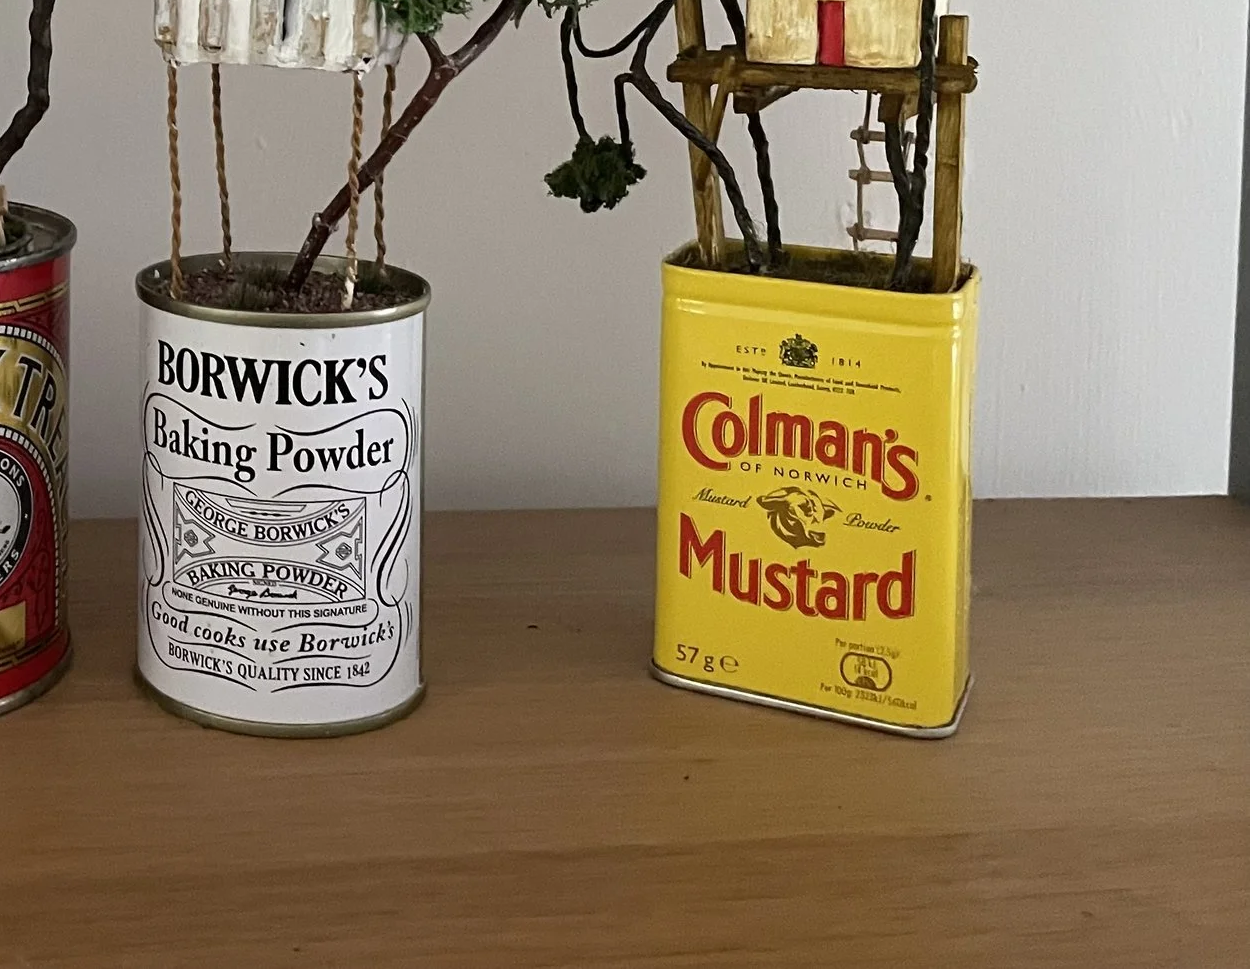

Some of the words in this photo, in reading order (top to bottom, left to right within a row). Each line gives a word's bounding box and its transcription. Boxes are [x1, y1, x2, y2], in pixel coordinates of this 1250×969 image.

[158, 339, 389, 406] BORWICK'S
[831, 357, 861, 369] 1814
[153, 407, 257, 483] Baking
[266, 428, 394, 473] Powder
[682, 391, 920, 502] Colman's
[740, 461, 762, 473] OF
[773, 466, 868, 490] NORWICH
[185, 490, 248, 538] GEORGE
[254, 503, 351, 542] BORWICK'S
[692, 486, 753, 509] Mustard
[843, 512, 902, 534] Powder
[186, 562, 256, 586] BAKING
[262, 563, 348, 600] POWDER
[679, 511, 918, 621] Mustard
[152, 600, 189, 634] Good
[193, 626, 246, 648] cooks
[253, 638, 290, 652] use
[297, 620, 395, 653] Borwick's
[171, 587, 194, 603] NONE
[195, 595, 236, 613] GENUINE
[237, 605, 285, 618] WITHOUT
[288, 609, 311, 618] THIS
[313, 603, 368, 618] SIGNATURE
[168, 641, 233, 675] BORWICK'S
[237, 663, 299, 681] QUALITY
[303, 665, 341, 681] SINCE
[347, 661, 370, 680] 1842
